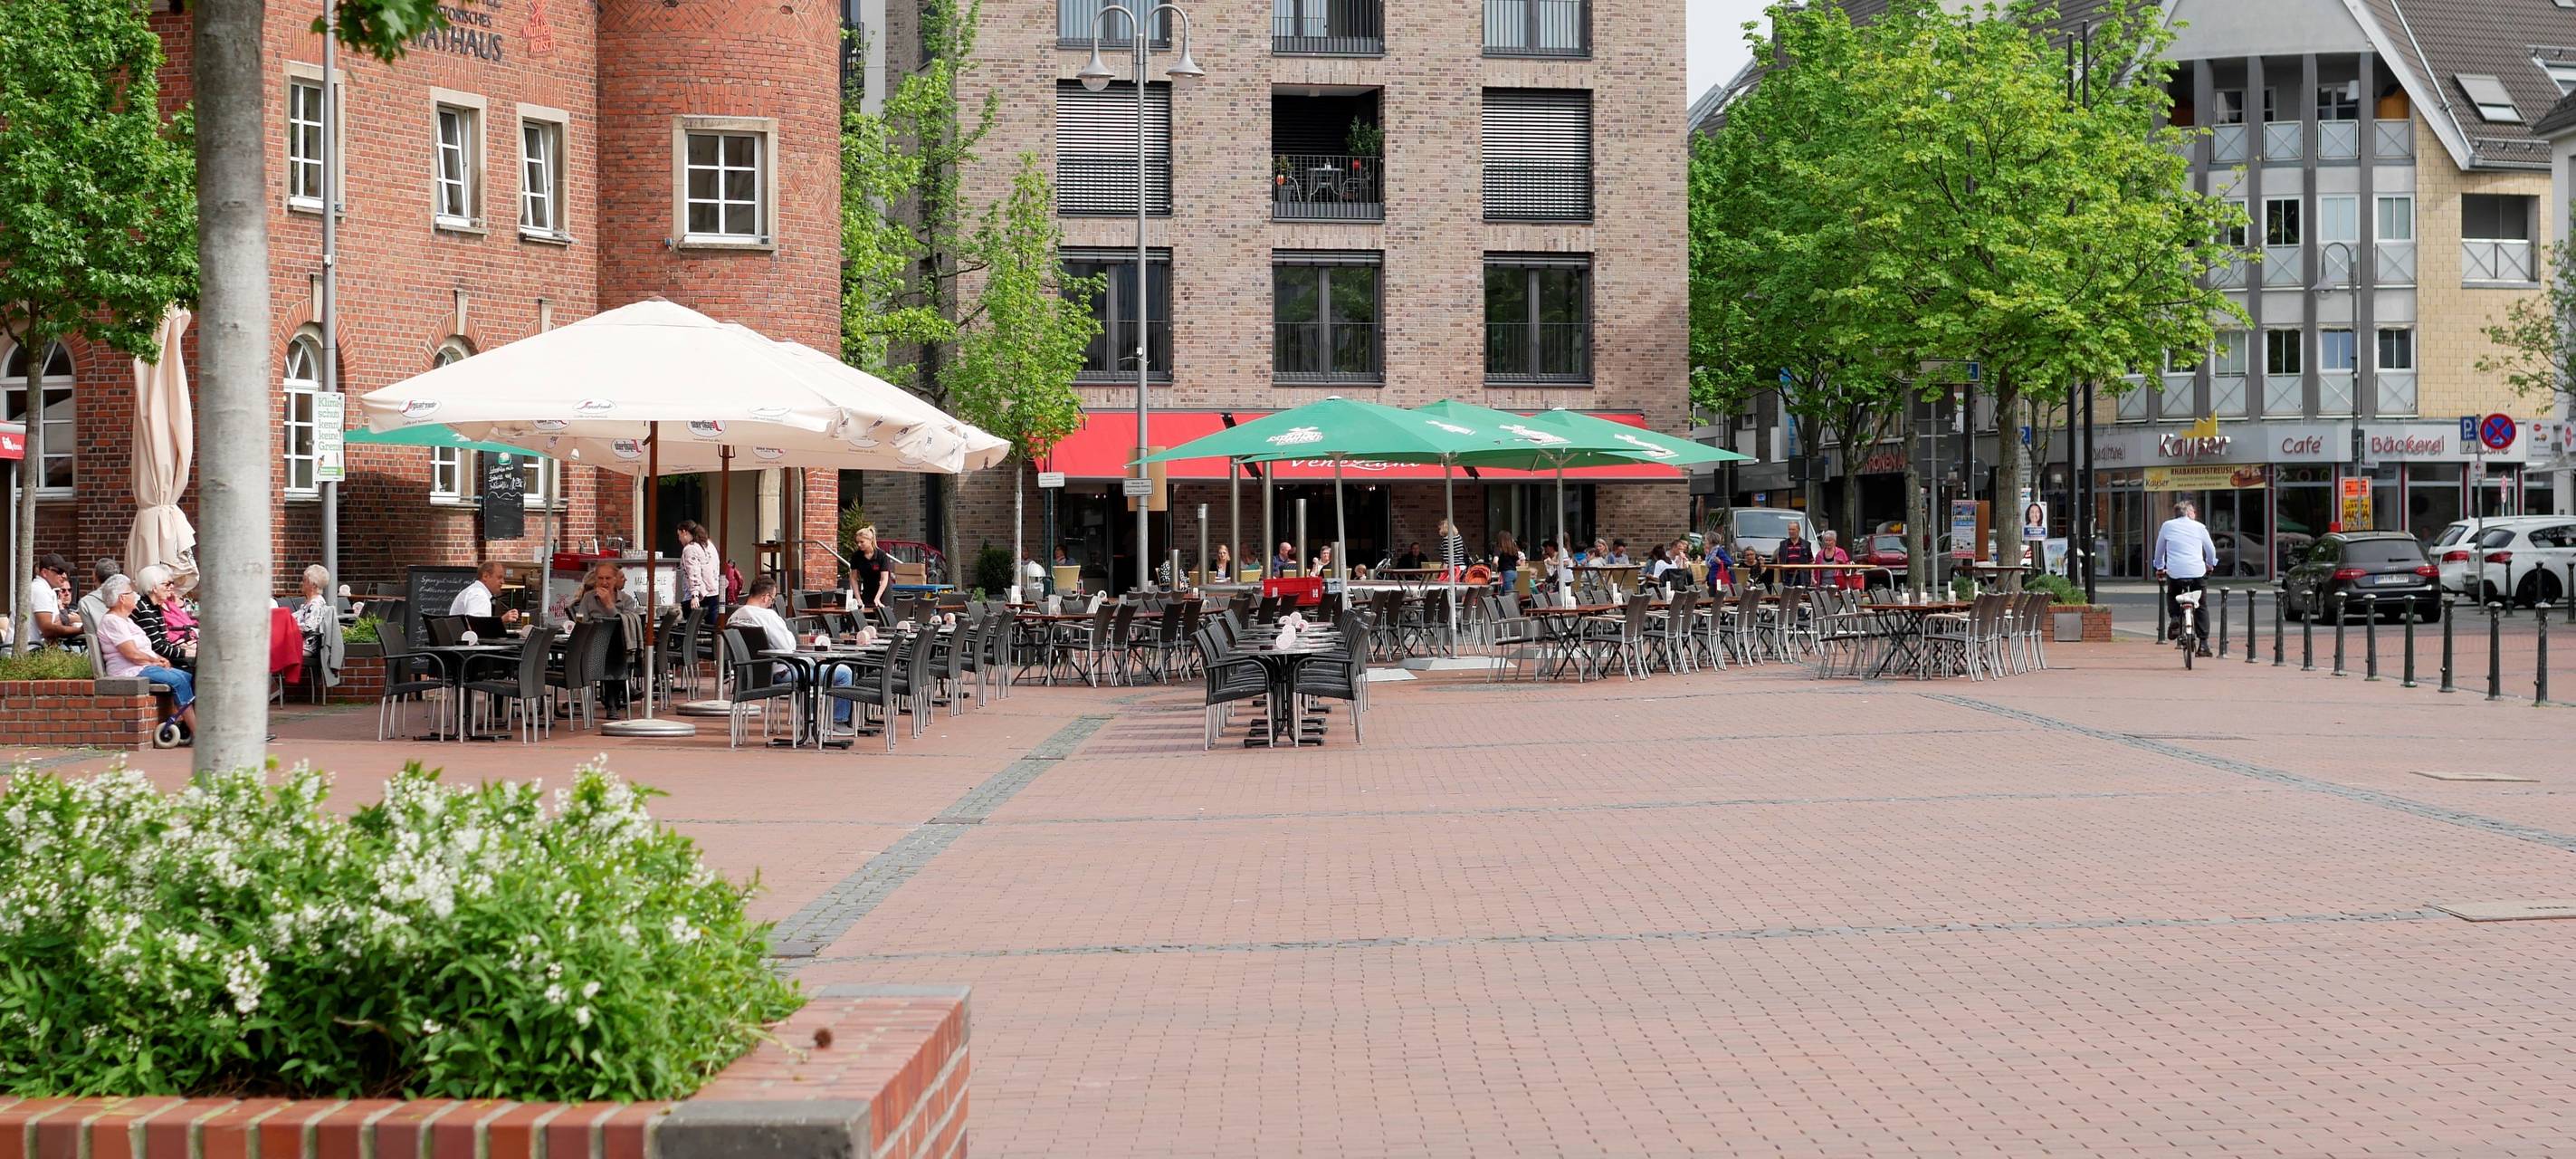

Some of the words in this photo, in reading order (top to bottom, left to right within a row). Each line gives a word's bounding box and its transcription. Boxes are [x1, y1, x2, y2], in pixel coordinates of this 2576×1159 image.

[413, 20, 503, 62] ATHAUS
[2159, 434, 2231, 464] Kayser
[2282, 435, 2323, 454] Café
[2371, 434, 2445, 455] Bäckerei
[2145, 478, 2171, 490] Kayser
